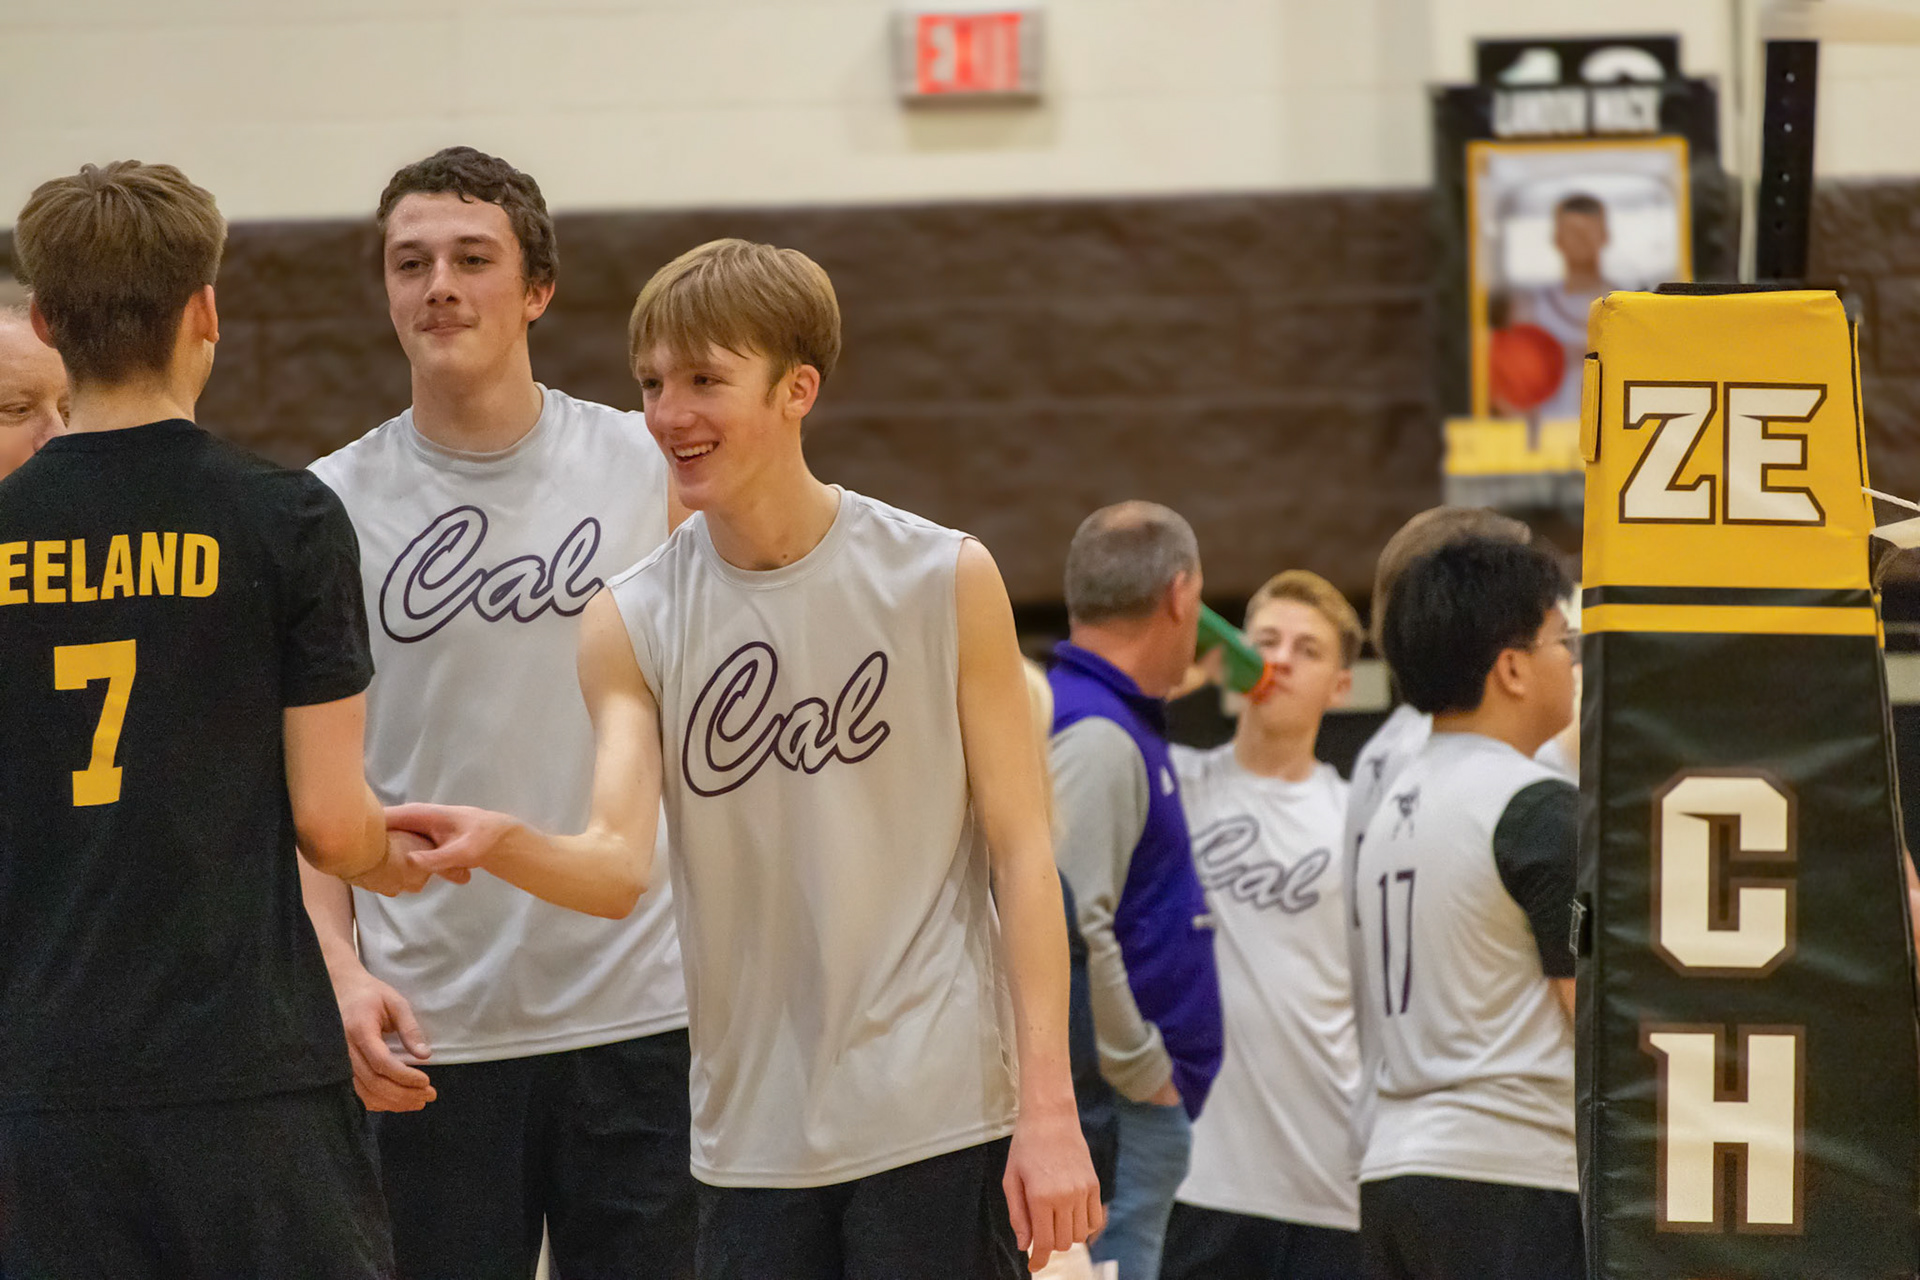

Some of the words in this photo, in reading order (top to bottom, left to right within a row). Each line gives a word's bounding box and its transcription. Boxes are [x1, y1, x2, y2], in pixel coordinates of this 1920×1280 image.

[1618, 380, 1828, 527] ZE
[0, 532, 220, 606] EELAND
[379, 505, 604, 643] Cal
[54, 639, 137, 806] 7
[682, 641, 890, 797] Cal
[1191, 814, 1330, 914] Cal
[1378, 868, 1415, 1016] 17
